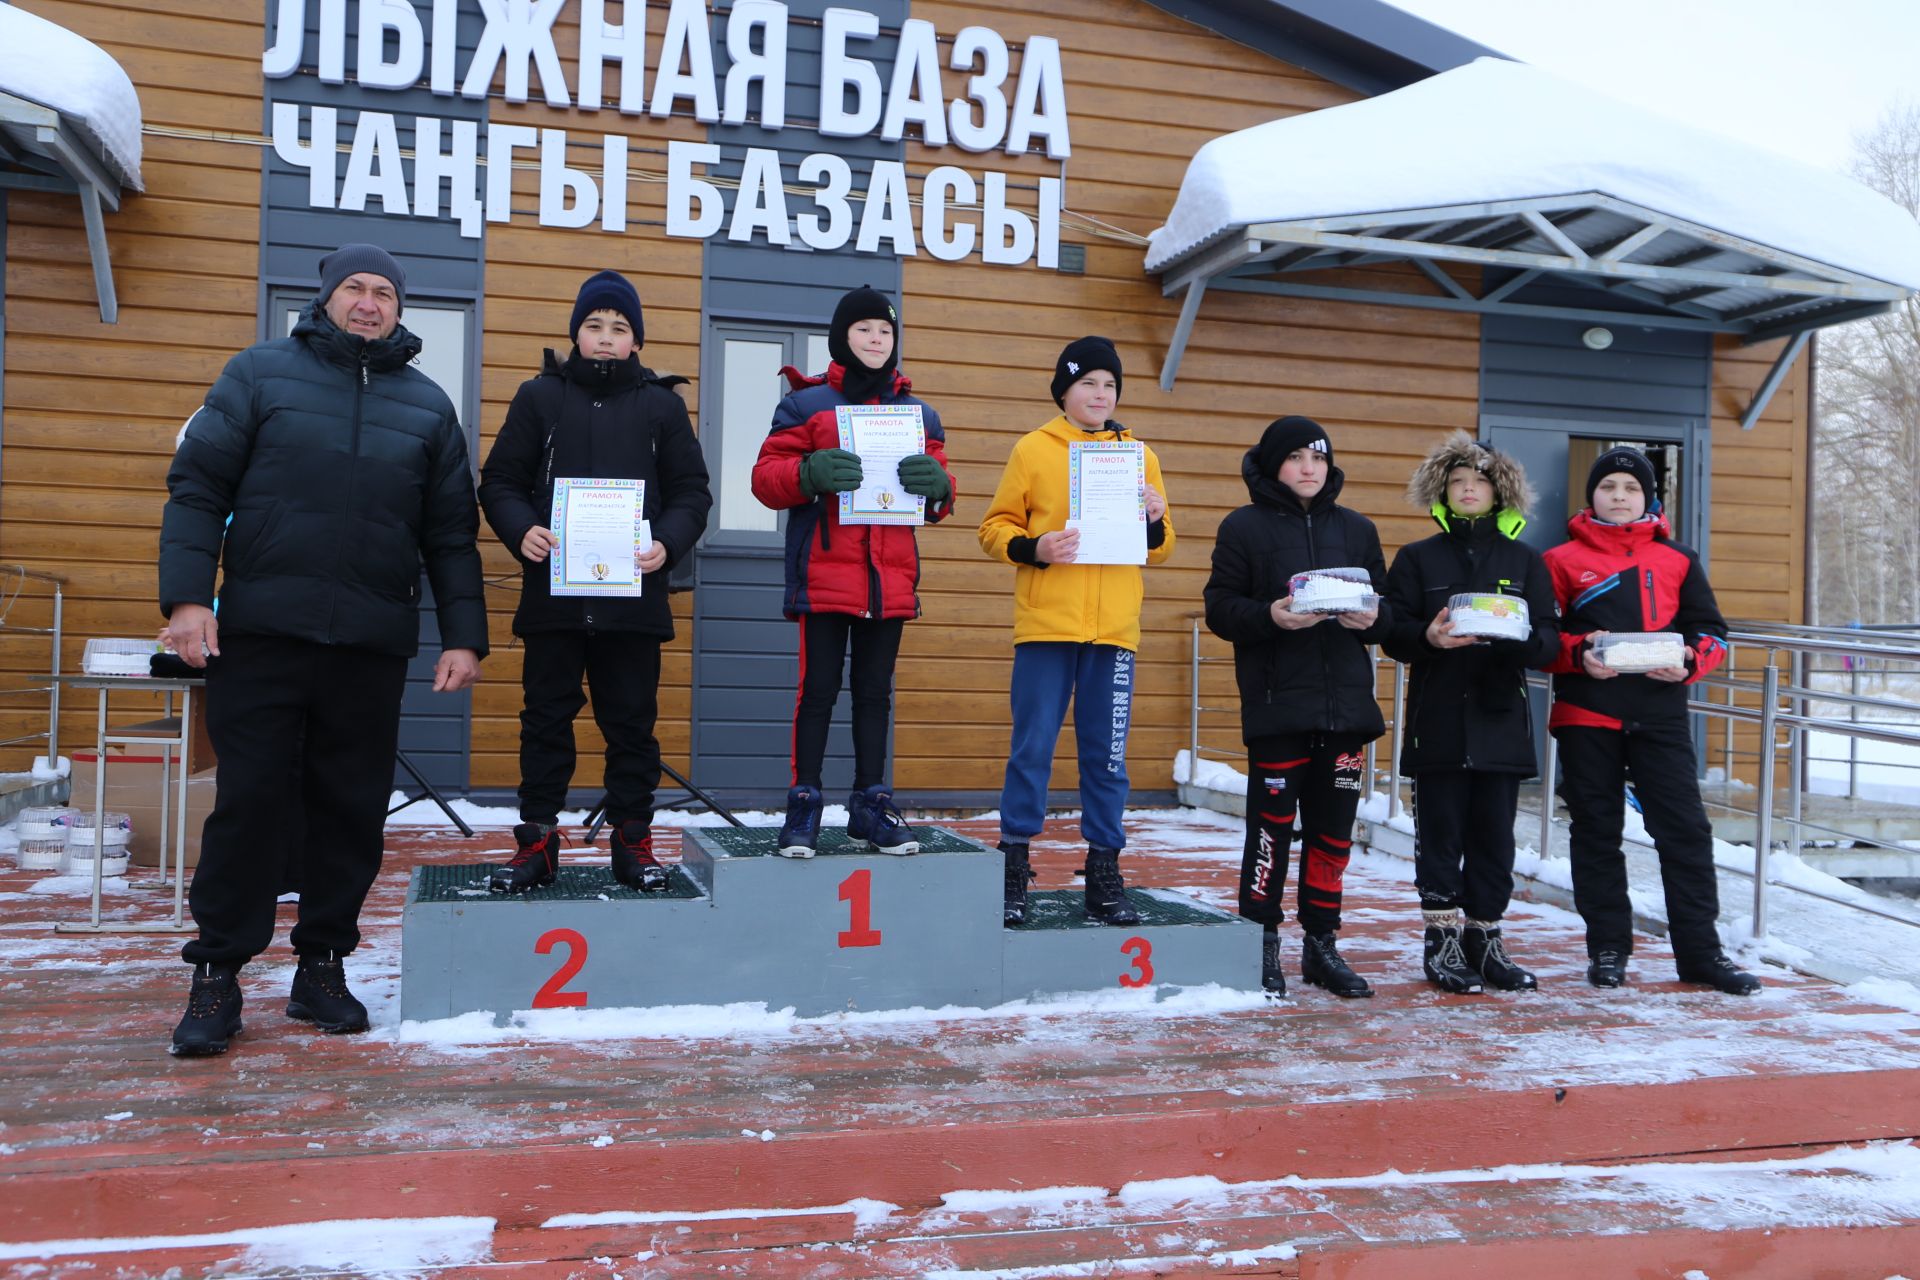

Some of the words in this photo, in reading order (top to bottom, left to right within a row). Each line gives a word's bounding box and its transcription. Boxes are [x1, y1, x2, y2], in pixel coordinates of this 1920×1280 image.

[262, 0, 789, 131] ЛЫЖНАЯ
[818, 7, 1072, 160] БАЗА
[272, 102, 629, 238] ЧАҢГЫ
[666, 140, 1061, 269] БАЗАСЫ
[864, 419, 904, 427] ГРАМОТА
[1091, 456, 1126, 464] ГРАМОТА
[1113, 647, 1132, 686] DYS
[837, 869, 882, 948] 1
[531, 928, 588, 1008] 2
[1118, 936, 1154, 987] 3
